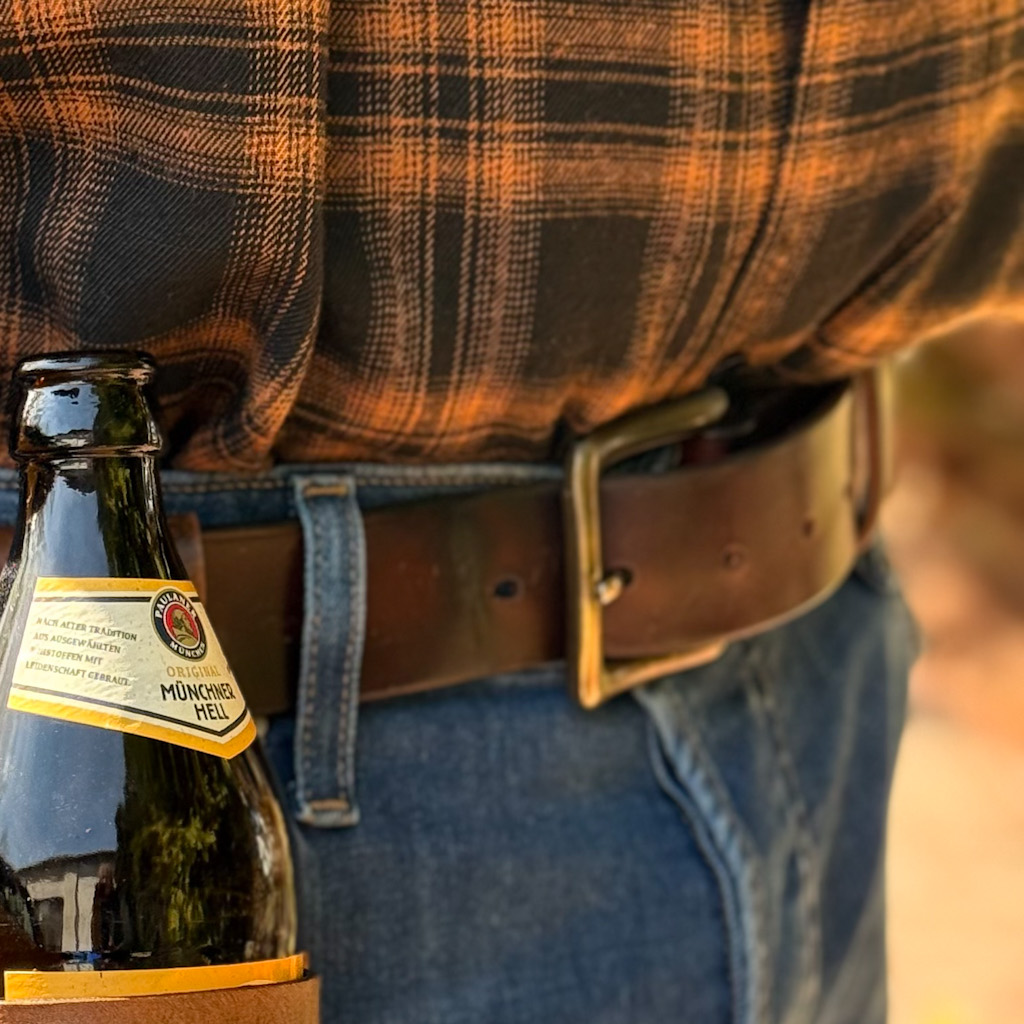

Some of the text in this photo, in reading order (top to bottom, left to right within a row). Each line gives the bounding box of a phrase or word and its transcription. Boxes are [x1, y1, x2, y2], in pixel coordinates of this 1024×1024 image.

[155, 592, 198, 620] PAULANER
[89, 625, 138, 642] TRADITION
[166, 666, 222, 678] ORIGINAL
[160, 680, 237, 702] MÜNCHNER
[193, 703, 230, 721] HELL
